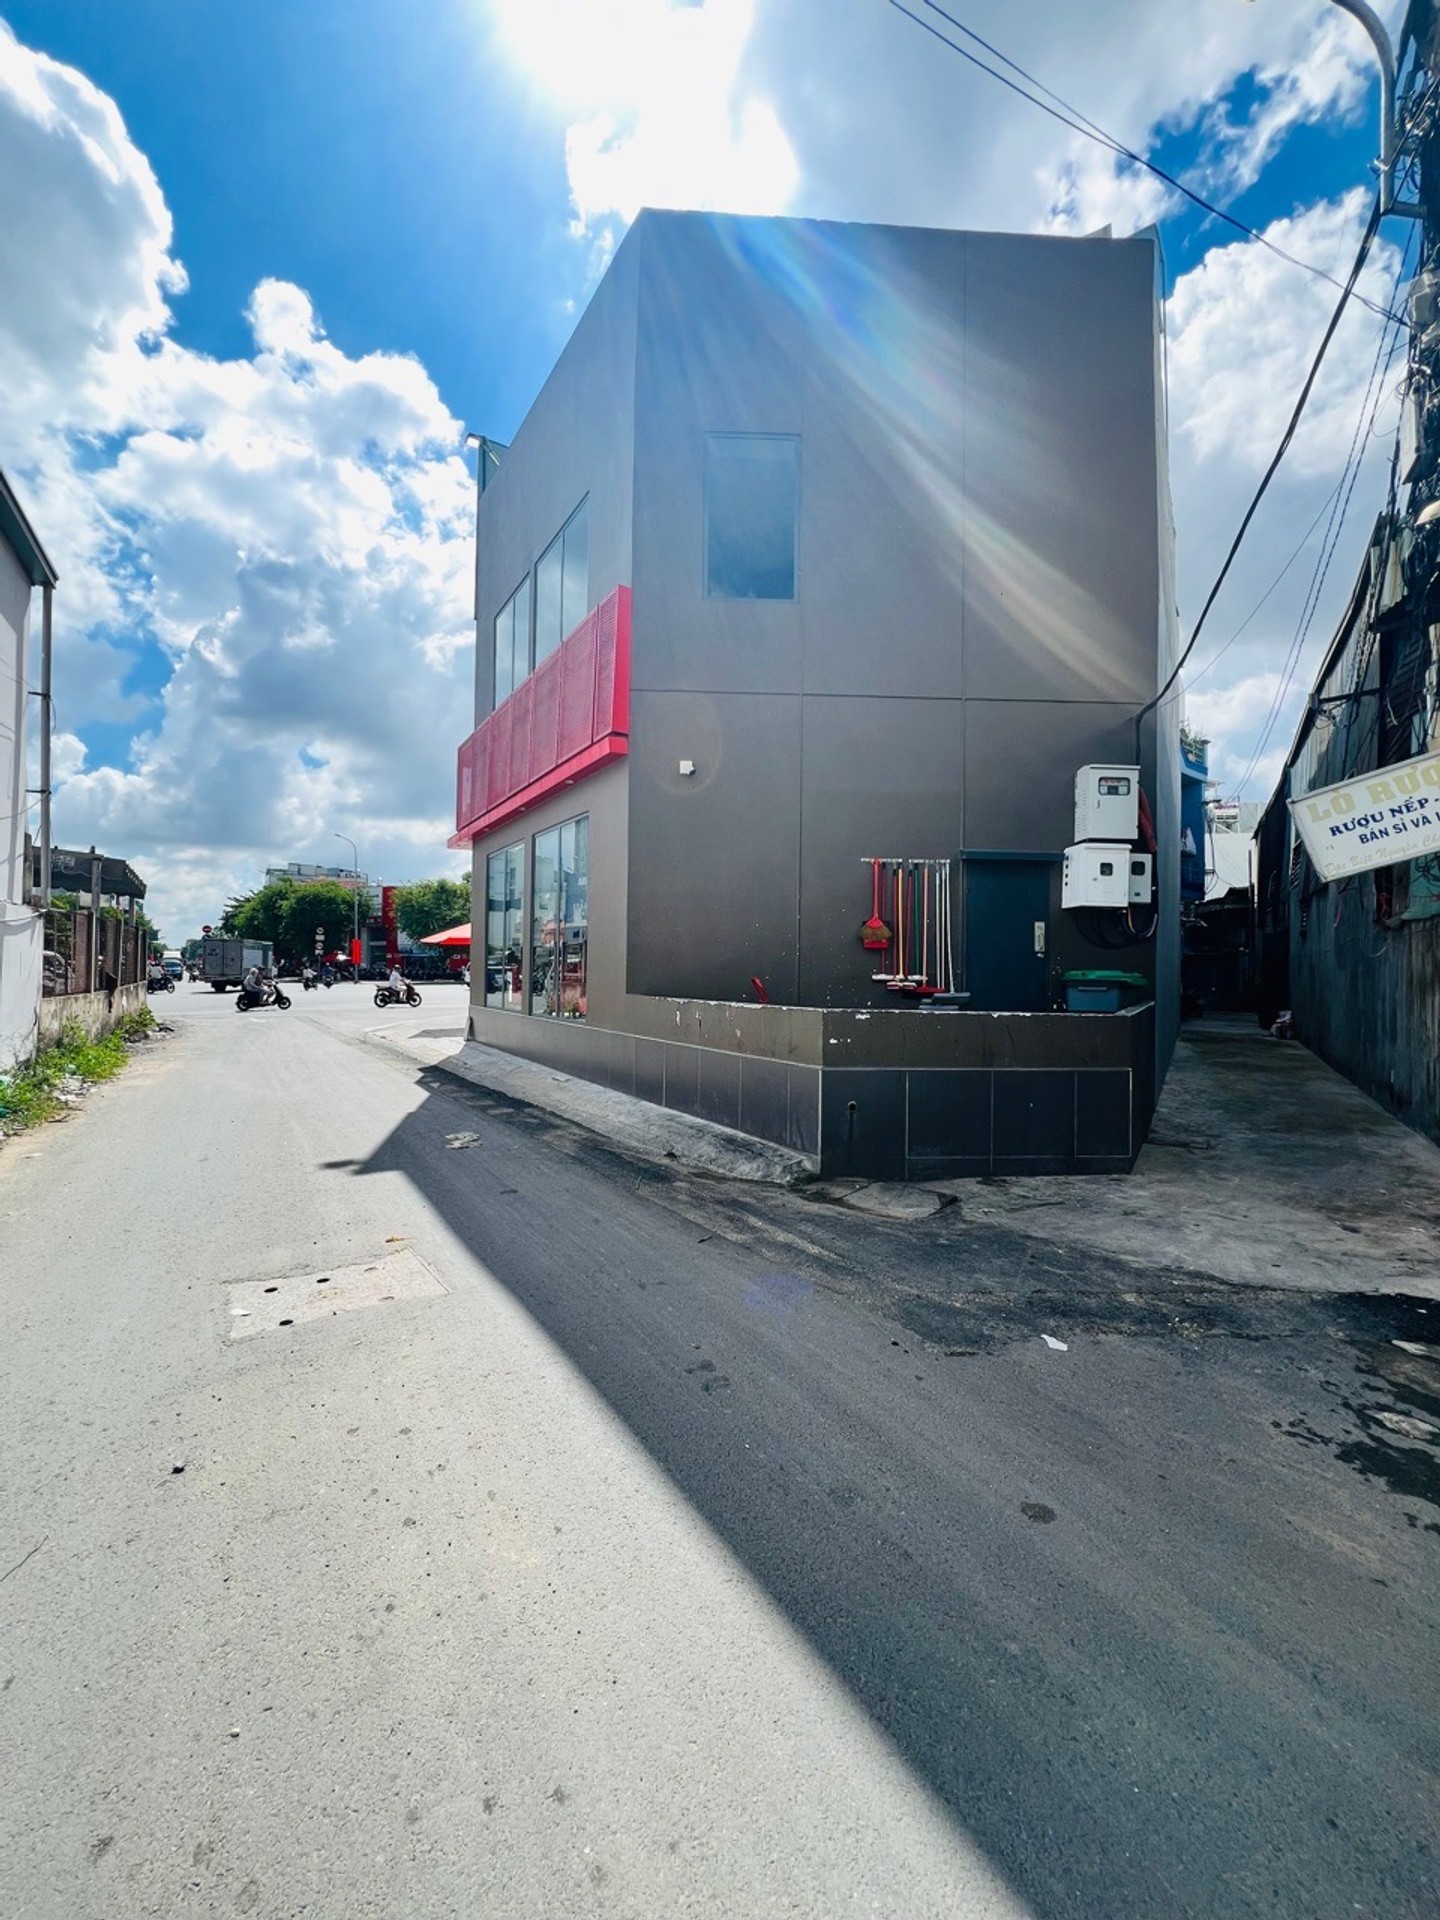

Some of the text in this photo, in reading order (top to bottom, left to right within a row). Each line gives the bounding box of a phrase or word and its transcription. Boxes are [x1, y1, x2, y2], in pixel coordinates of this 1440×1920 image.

[1305, 789, 1357, 823] LÒ
[1329, 811, 1384, 837] RƯỢU
[1389, 796, 1429, 818] NẾP
[1359, 827, 1389, 845] BÁN
[1392, 817, 1408, 835] SỈ
[1411, 813, 1432, 829] VÀ
